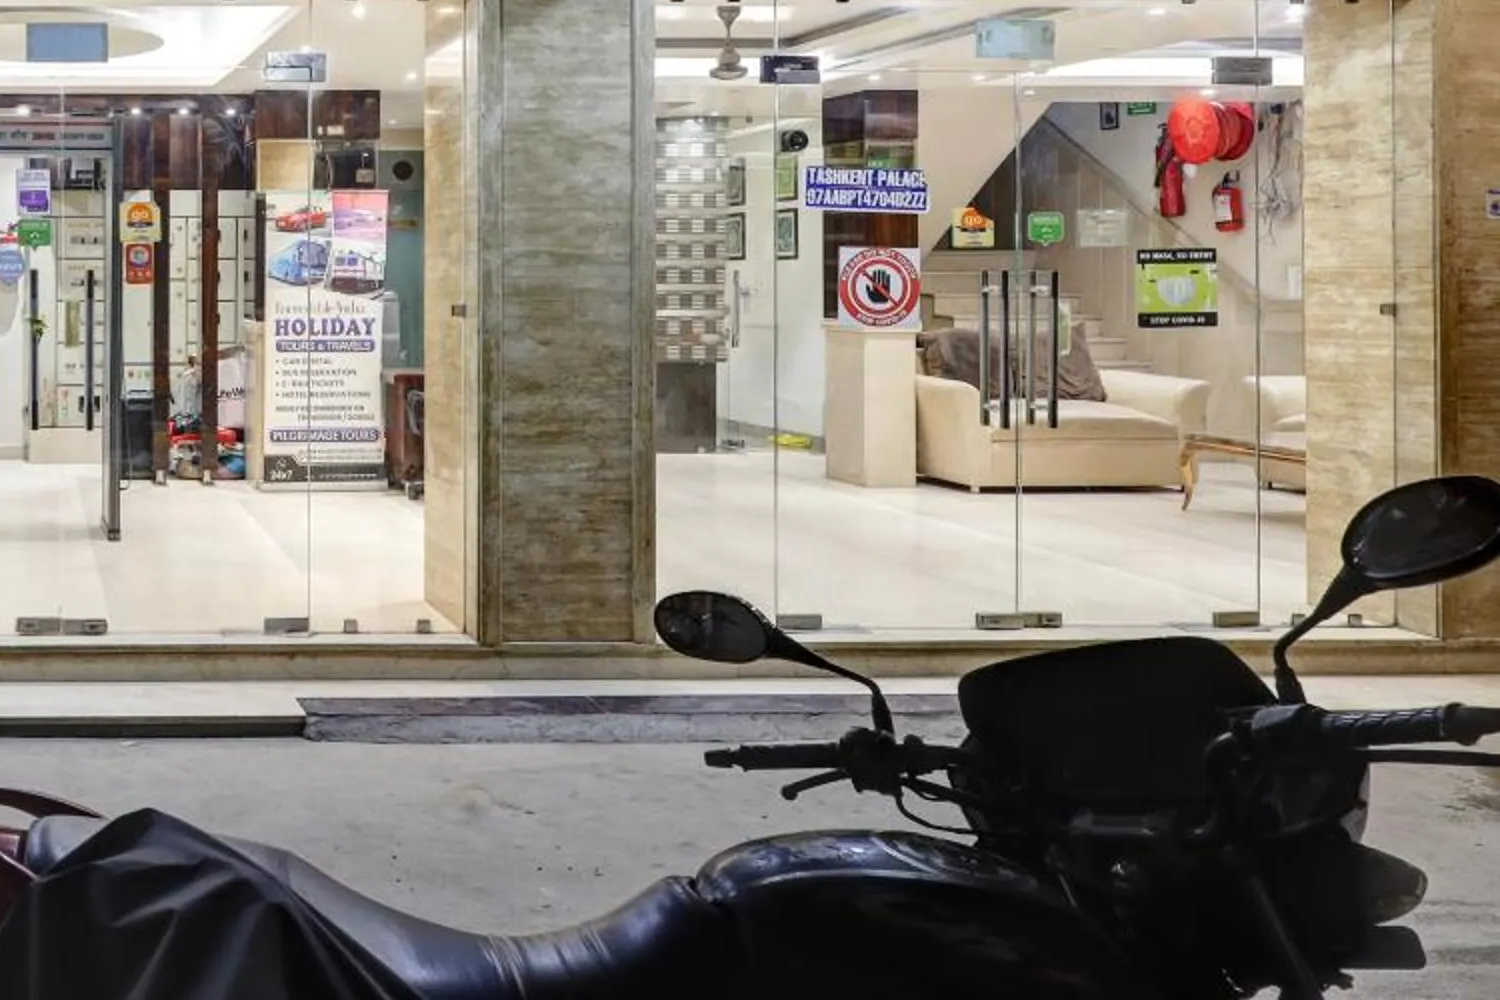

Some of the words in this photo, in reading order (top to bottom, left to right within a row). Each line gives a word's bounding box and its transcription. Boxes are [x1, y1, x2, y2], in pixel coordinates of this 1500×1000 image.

[807, 167, 875, 186] TASHKENT
[877, 169, 926, 188] PALACE
[275, 316, 376, 337] HOLIDAY
